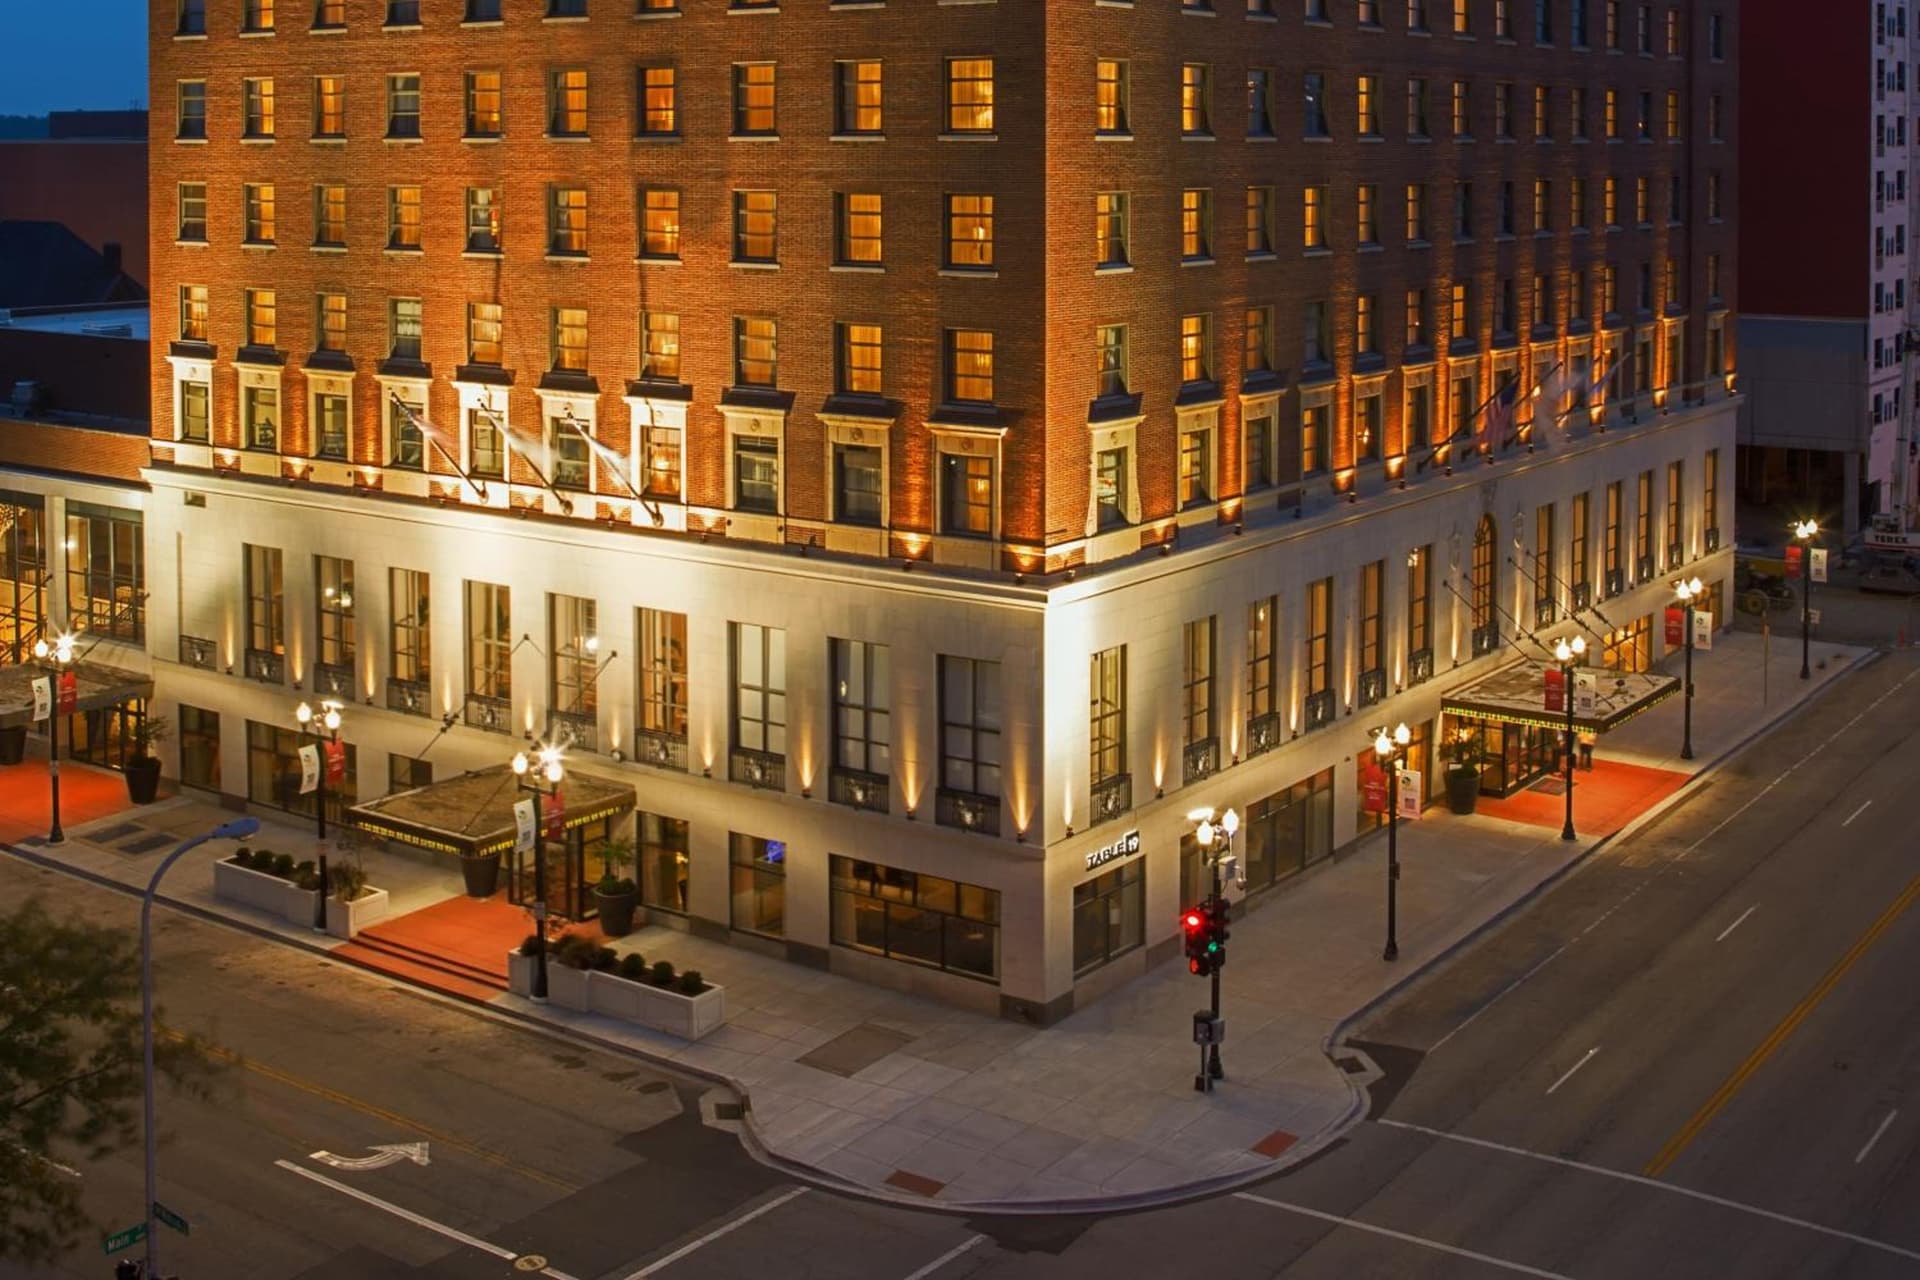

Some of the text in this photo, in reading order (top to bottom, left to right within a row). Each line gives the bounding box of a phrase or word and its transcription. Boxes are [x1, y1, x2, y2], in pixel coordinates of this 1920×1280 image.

[1086, 835, 1139, 869] TABLE 19
[107, 1232, 130, 1251] Main
